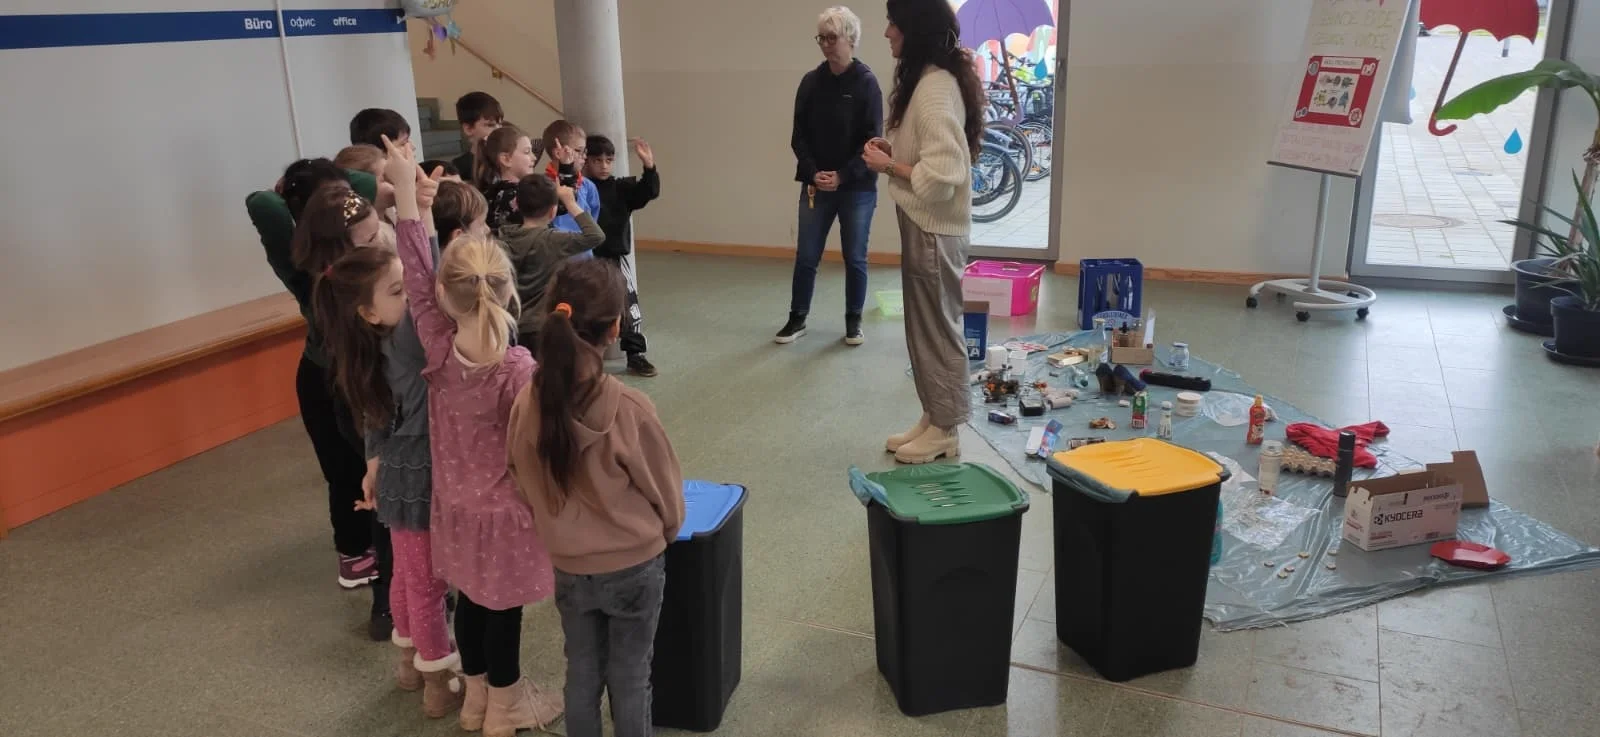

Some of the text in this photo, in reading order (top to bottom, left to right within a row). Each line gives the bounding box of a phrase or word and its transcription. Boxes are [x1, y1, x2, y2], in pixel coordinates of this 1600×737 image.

[244, 18, 273, 30] Büro
[290, 16, 316, 30] офис
[333, 16, 357, 26] office
[1384, 509, 1424, 523] KYOCERA
